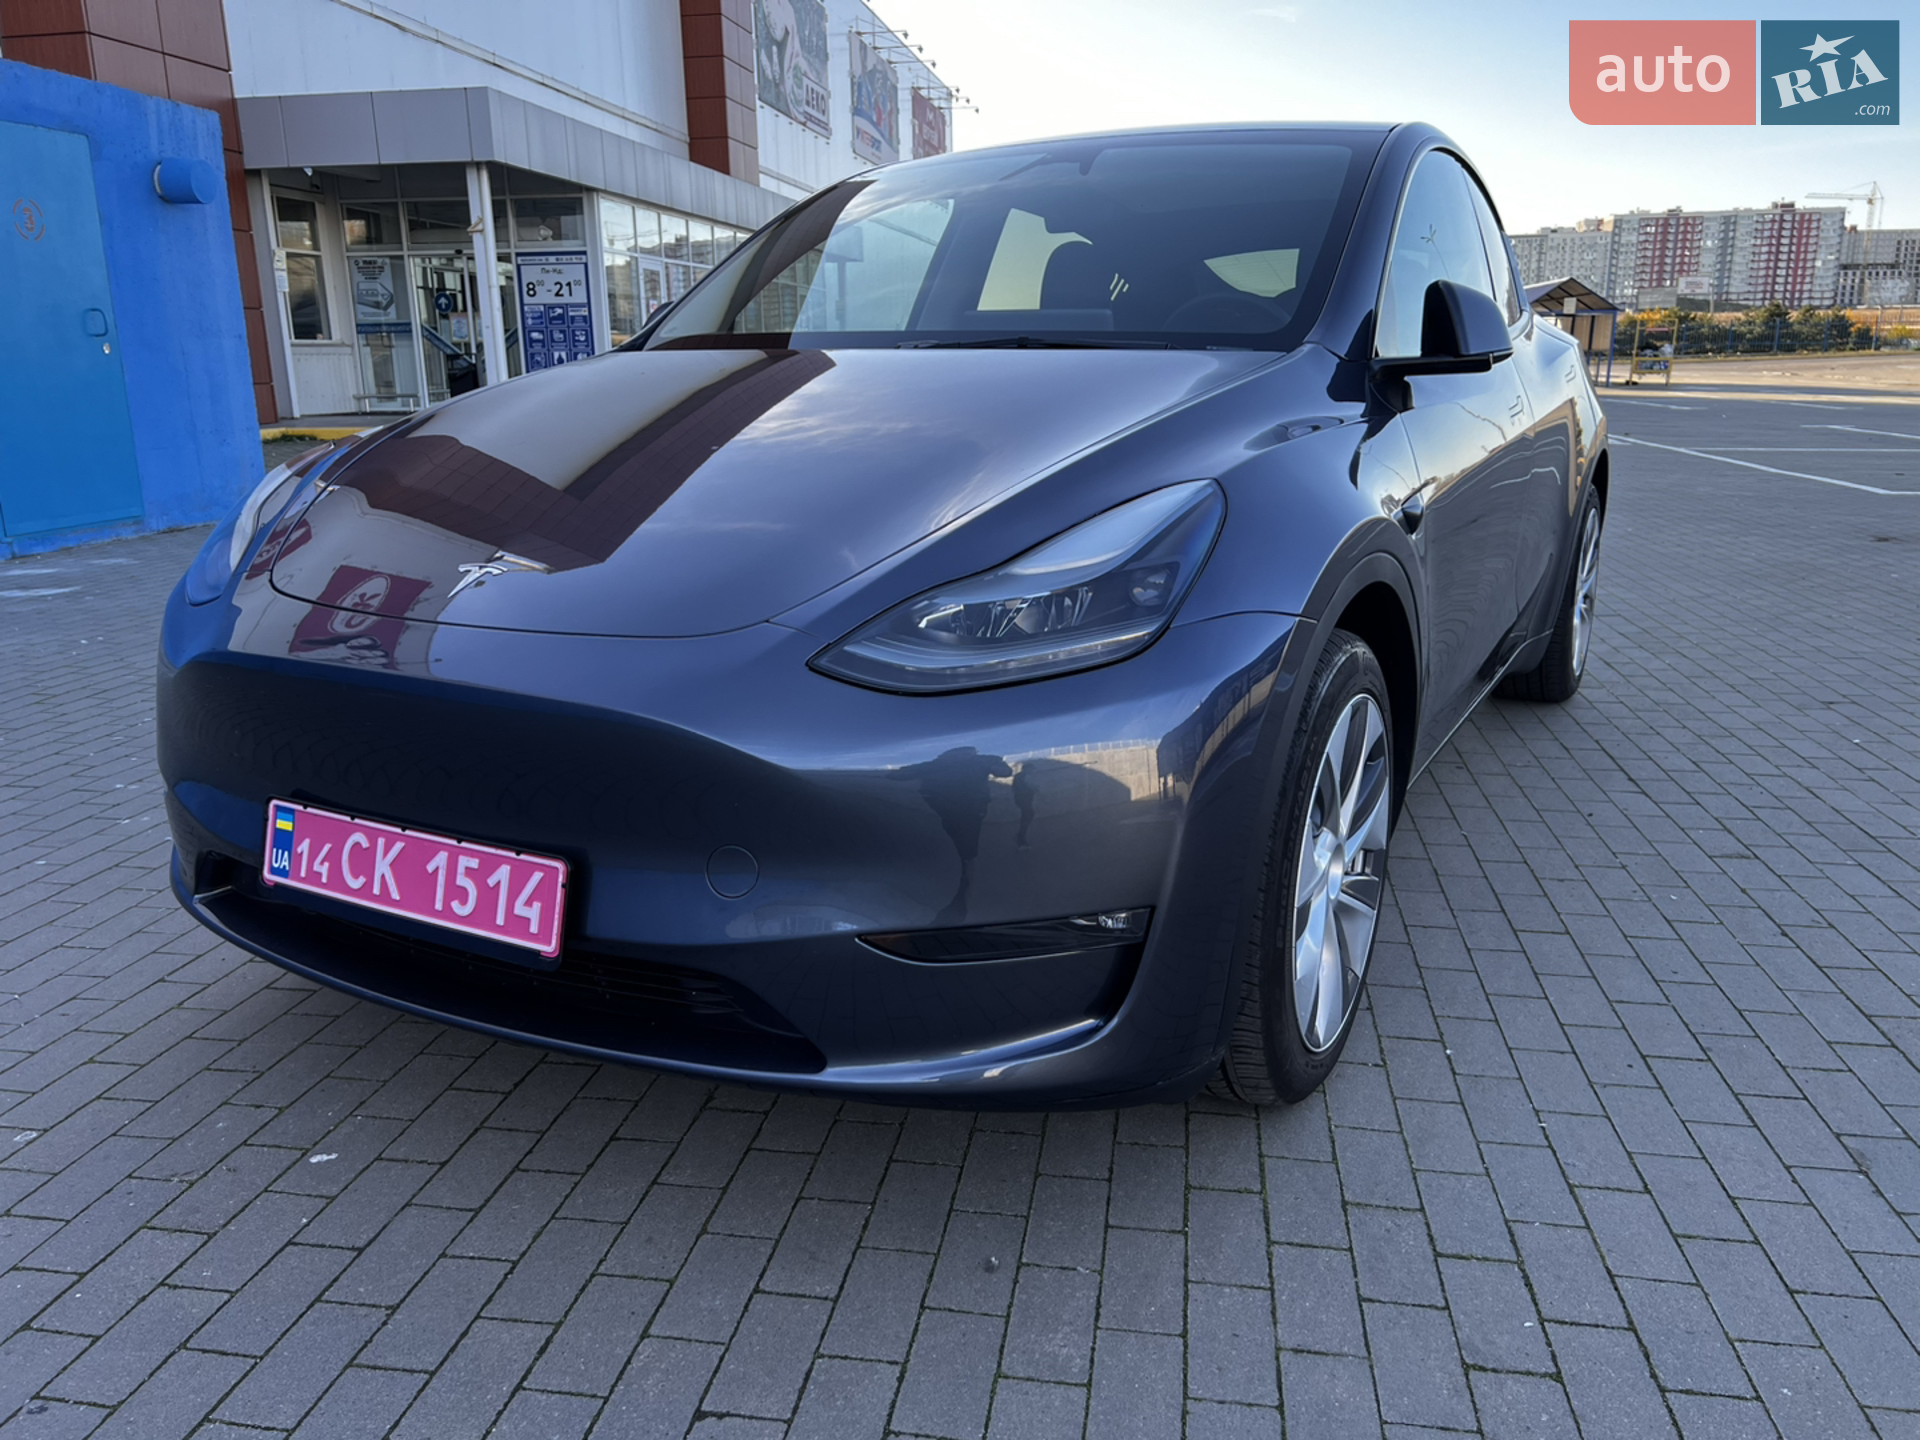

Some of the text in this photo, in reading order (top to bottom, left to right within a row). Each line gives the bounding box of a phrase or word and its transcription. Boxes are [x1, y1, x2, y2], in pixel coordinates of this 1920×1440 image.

[271, 847, 290, 871] UA
[296, 831, 544, 935] 14 CK 1514
